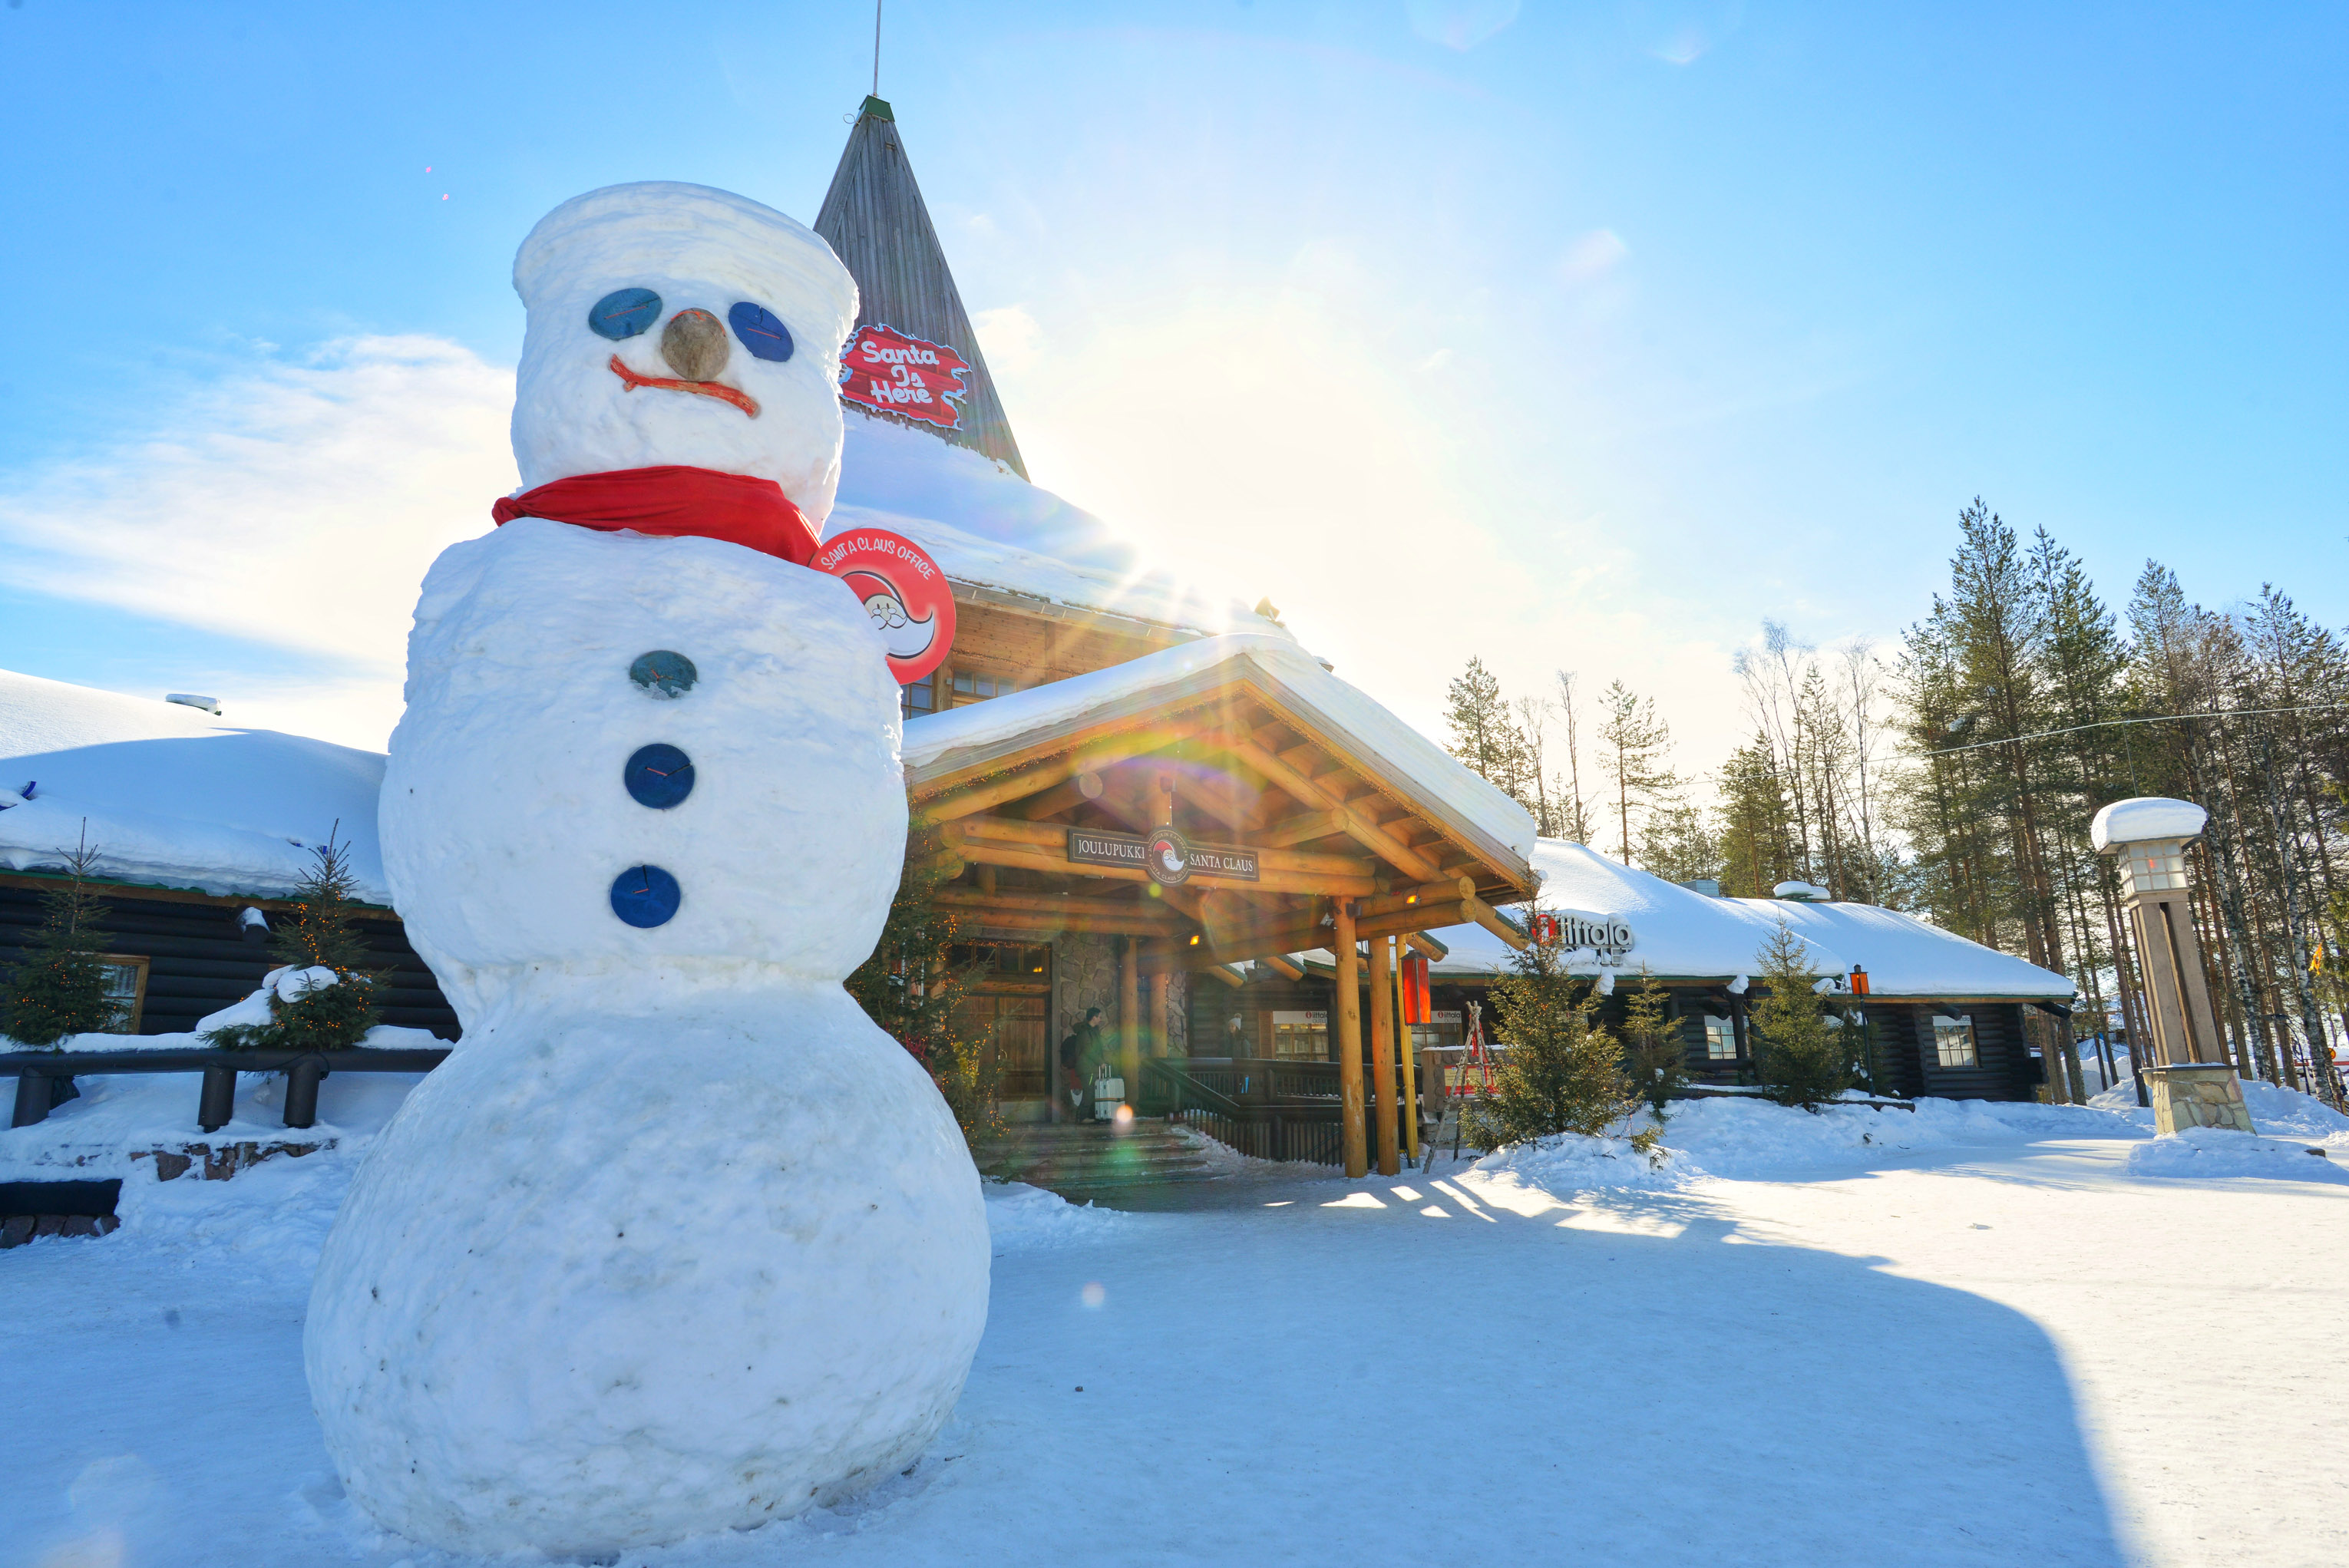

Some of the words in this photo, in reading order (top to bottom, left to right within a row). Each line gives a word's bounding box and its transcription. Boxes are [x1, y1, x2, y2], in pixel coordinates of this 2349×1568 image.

[861, 340, 940, 365] Santa
[890, 365, 925, 388] Is
[870, 381, 933, 404] Here
[821, 540, 857, 569] SANTA
[857, 537, 895, 555] CLAUS
[897, 546, 935, 580] OFFICE
[1078, 840, 1145, 860] JOULUPUKKI
[1190, 853, 1221, 869] SANTA
[1223, 857, 1254, 872] CLAUS
[1560, 917, 1633, 946] iittala
